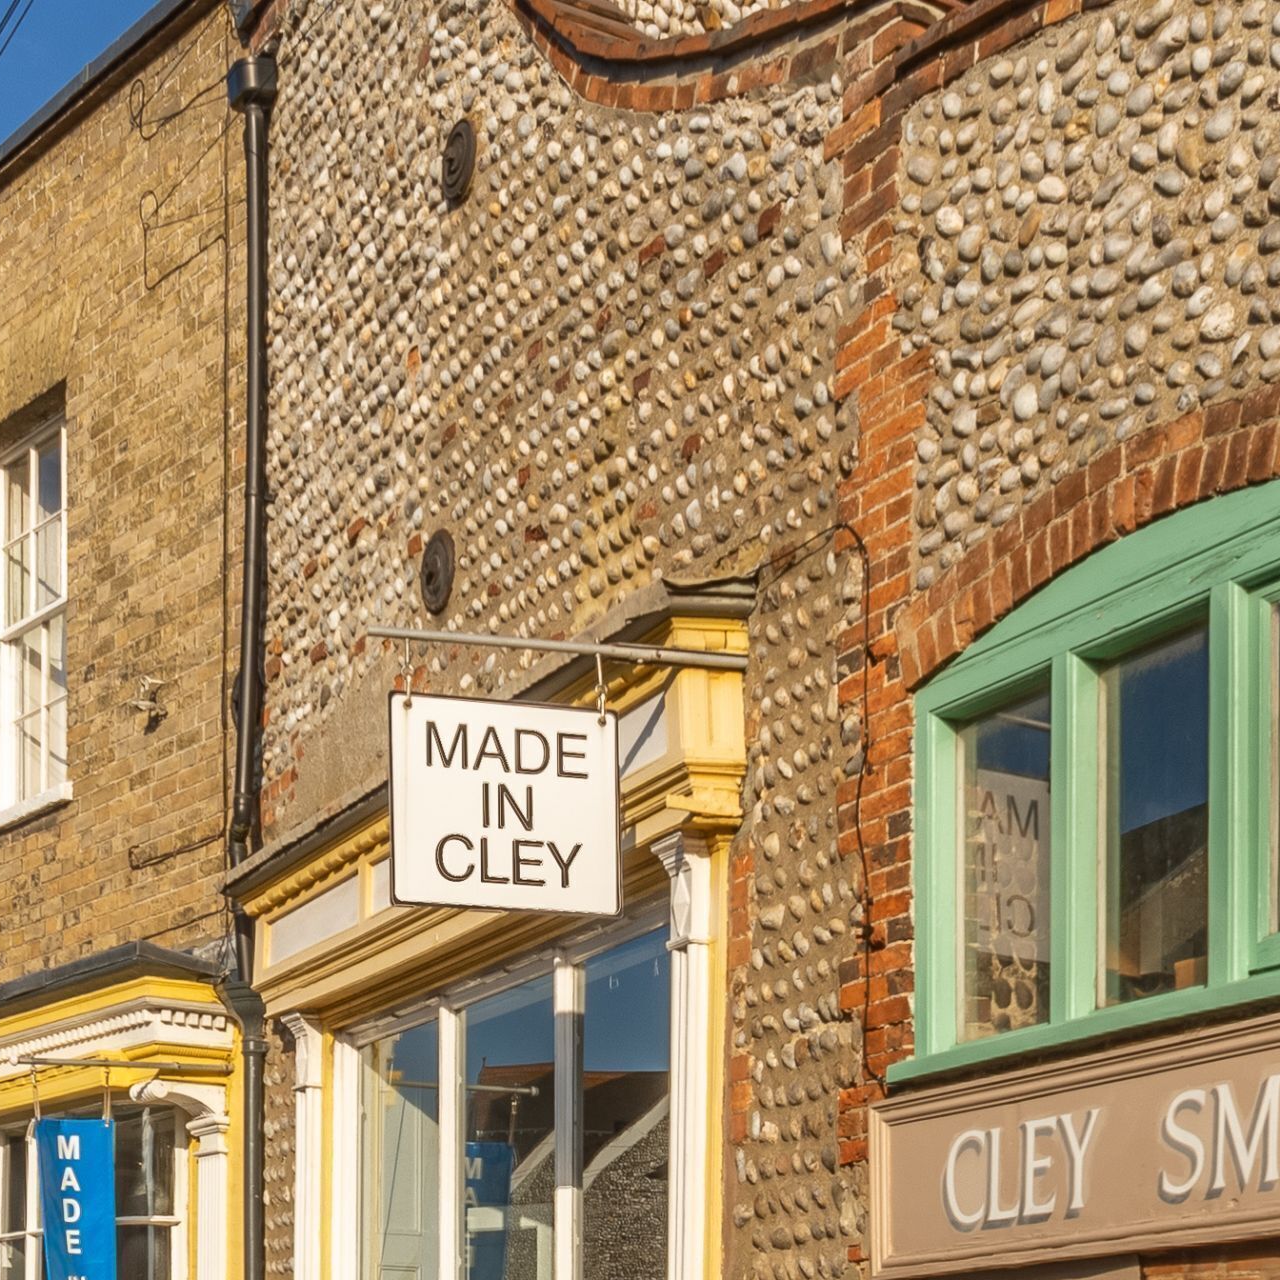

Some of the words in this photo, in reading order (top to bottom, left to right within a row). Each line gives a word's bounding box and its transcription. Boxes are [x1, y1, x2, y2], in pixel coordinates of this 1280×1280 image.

[425, 720, 589, 779] MADE
[482, 782, 534, 831] IN
[435, 834, 583, 889] CLEY
[57, 1134, 82, 1255] MADE
[942, 1106, 1101, 1232] CLEY
